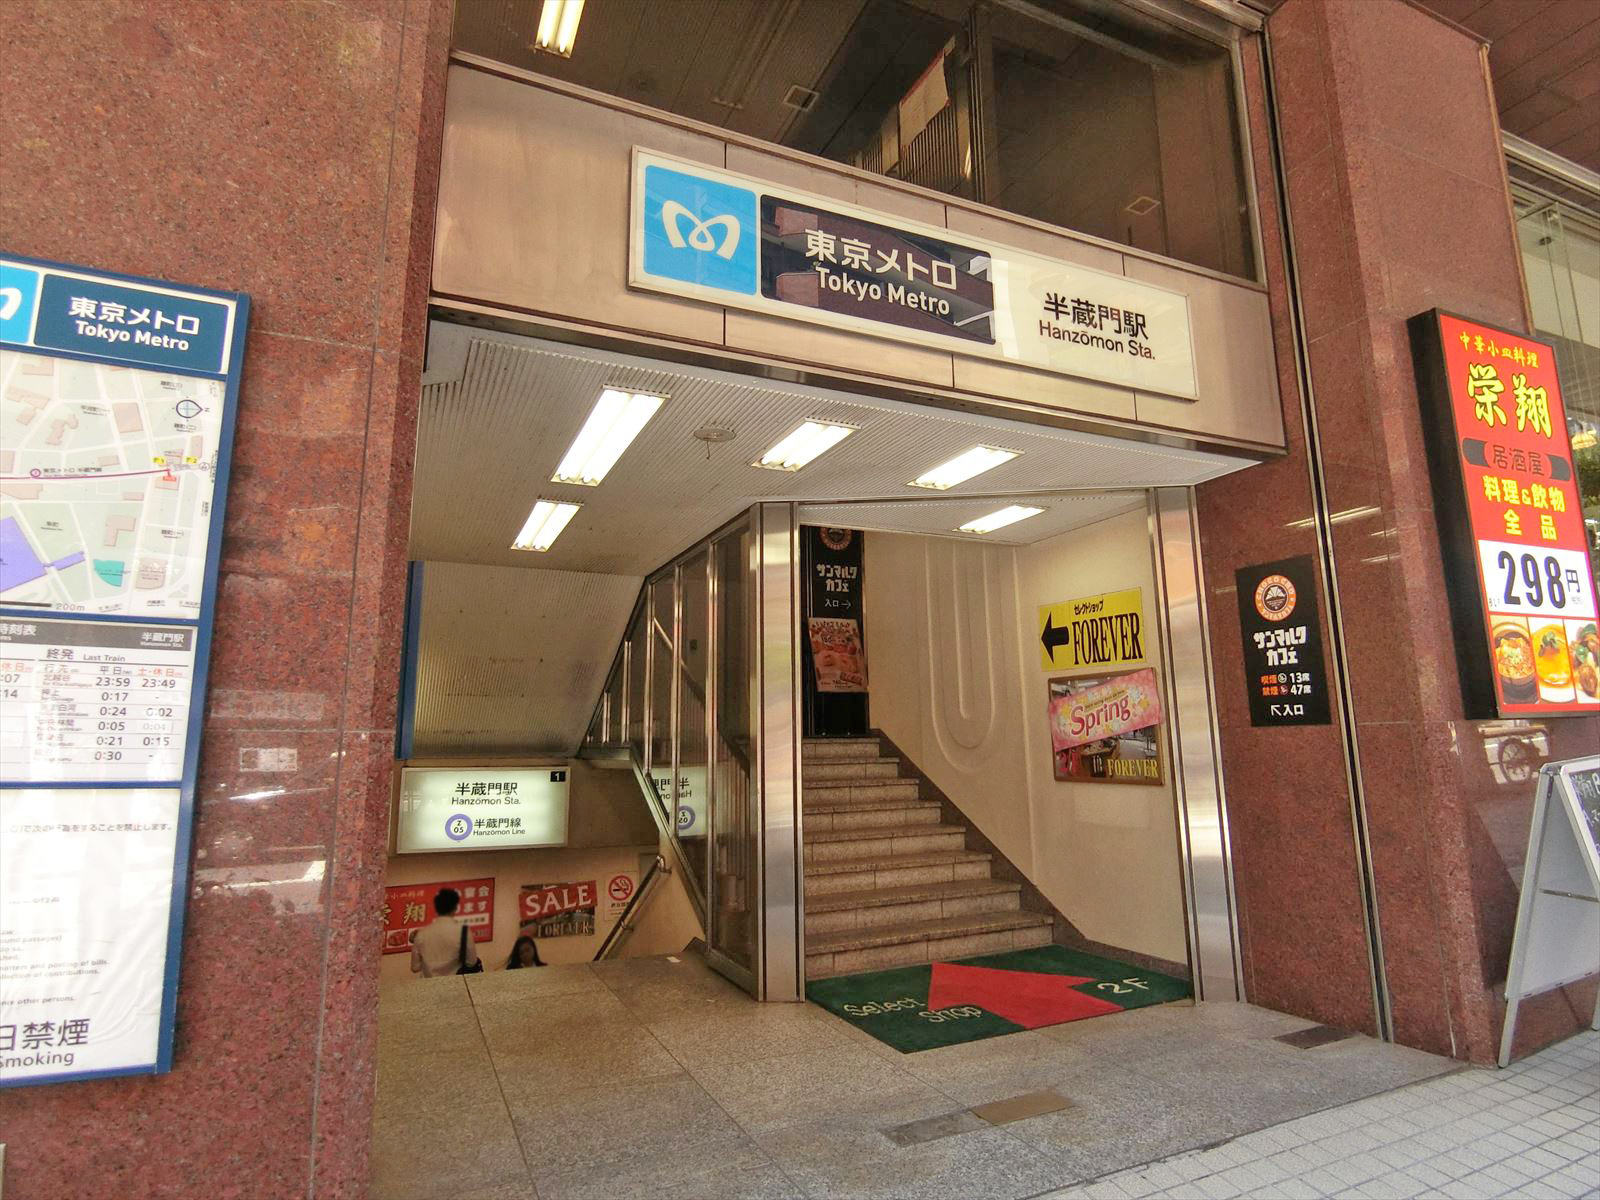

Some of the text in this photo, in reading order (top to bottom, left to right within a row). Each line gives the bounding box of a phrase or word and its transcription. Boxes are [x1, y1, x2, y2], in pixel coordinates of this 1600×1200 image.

[805, 229, 957, 290] 東京メトロ
[816, 266, 950, 315] Tokyo Metro
[68, 296, 200, 335] 東京メトロ
[1043, 292, 1149, 340] 半蔵門駅
[75, 320, 190, 351] Tokyo Metro
[1039, 319, 1156, 360] Hanzōmon Sta.
[1459, 331, 1539, 368] 中華小皿料理
[1492, 444, 1544, 476] 居酒屋
[816, 563, 857, 579] サンマルク
[825, 579, 849, 593] カフェ
[56, 602, 86, 611] 200m
[824, 599, 840, 608] 入口
[1074, 599, 1104, 616] セレクトショップ
[141, 631, 185, 643] 半蔵門駅
[1071, 612, 1144, 665] FOREVER
[1253, 625, 1307, 650] サンマルク
[47, 648, 74, 660] 終発
[83, 653, 126, 662] Last Train
[1266, 647, 1299, 667] カフェ
[96, 677, 131, 687] 23:59
[142, 678, 176, 688] 23:49
[101, 692, 129, 702] 0:17
[100, 706, 127, 716] 0:24
[1070, 694, 1131, 737] Spring
[1282, 704, 1305, 717] 入口
[98, 721, 126, 731] 0:05
[96, 736, 123, 746] 0:21
[143, 736, 170, 746] 0:15
[94, 751, 122, 761] 0:30
[1106, 759, 1159, 778] FOREVER
[455, 781, 519, 796] 半蔵門駅
[504, 796, 521, 805] Sta.
[474, 817, 522, 829] 半蔵門線
[525, 885, 592, 916] SALE
[1096, 977, 1150, 994] 2F
[843, 996, 927, 1017] Select
[919, 1004, 983, 1024] Shop
